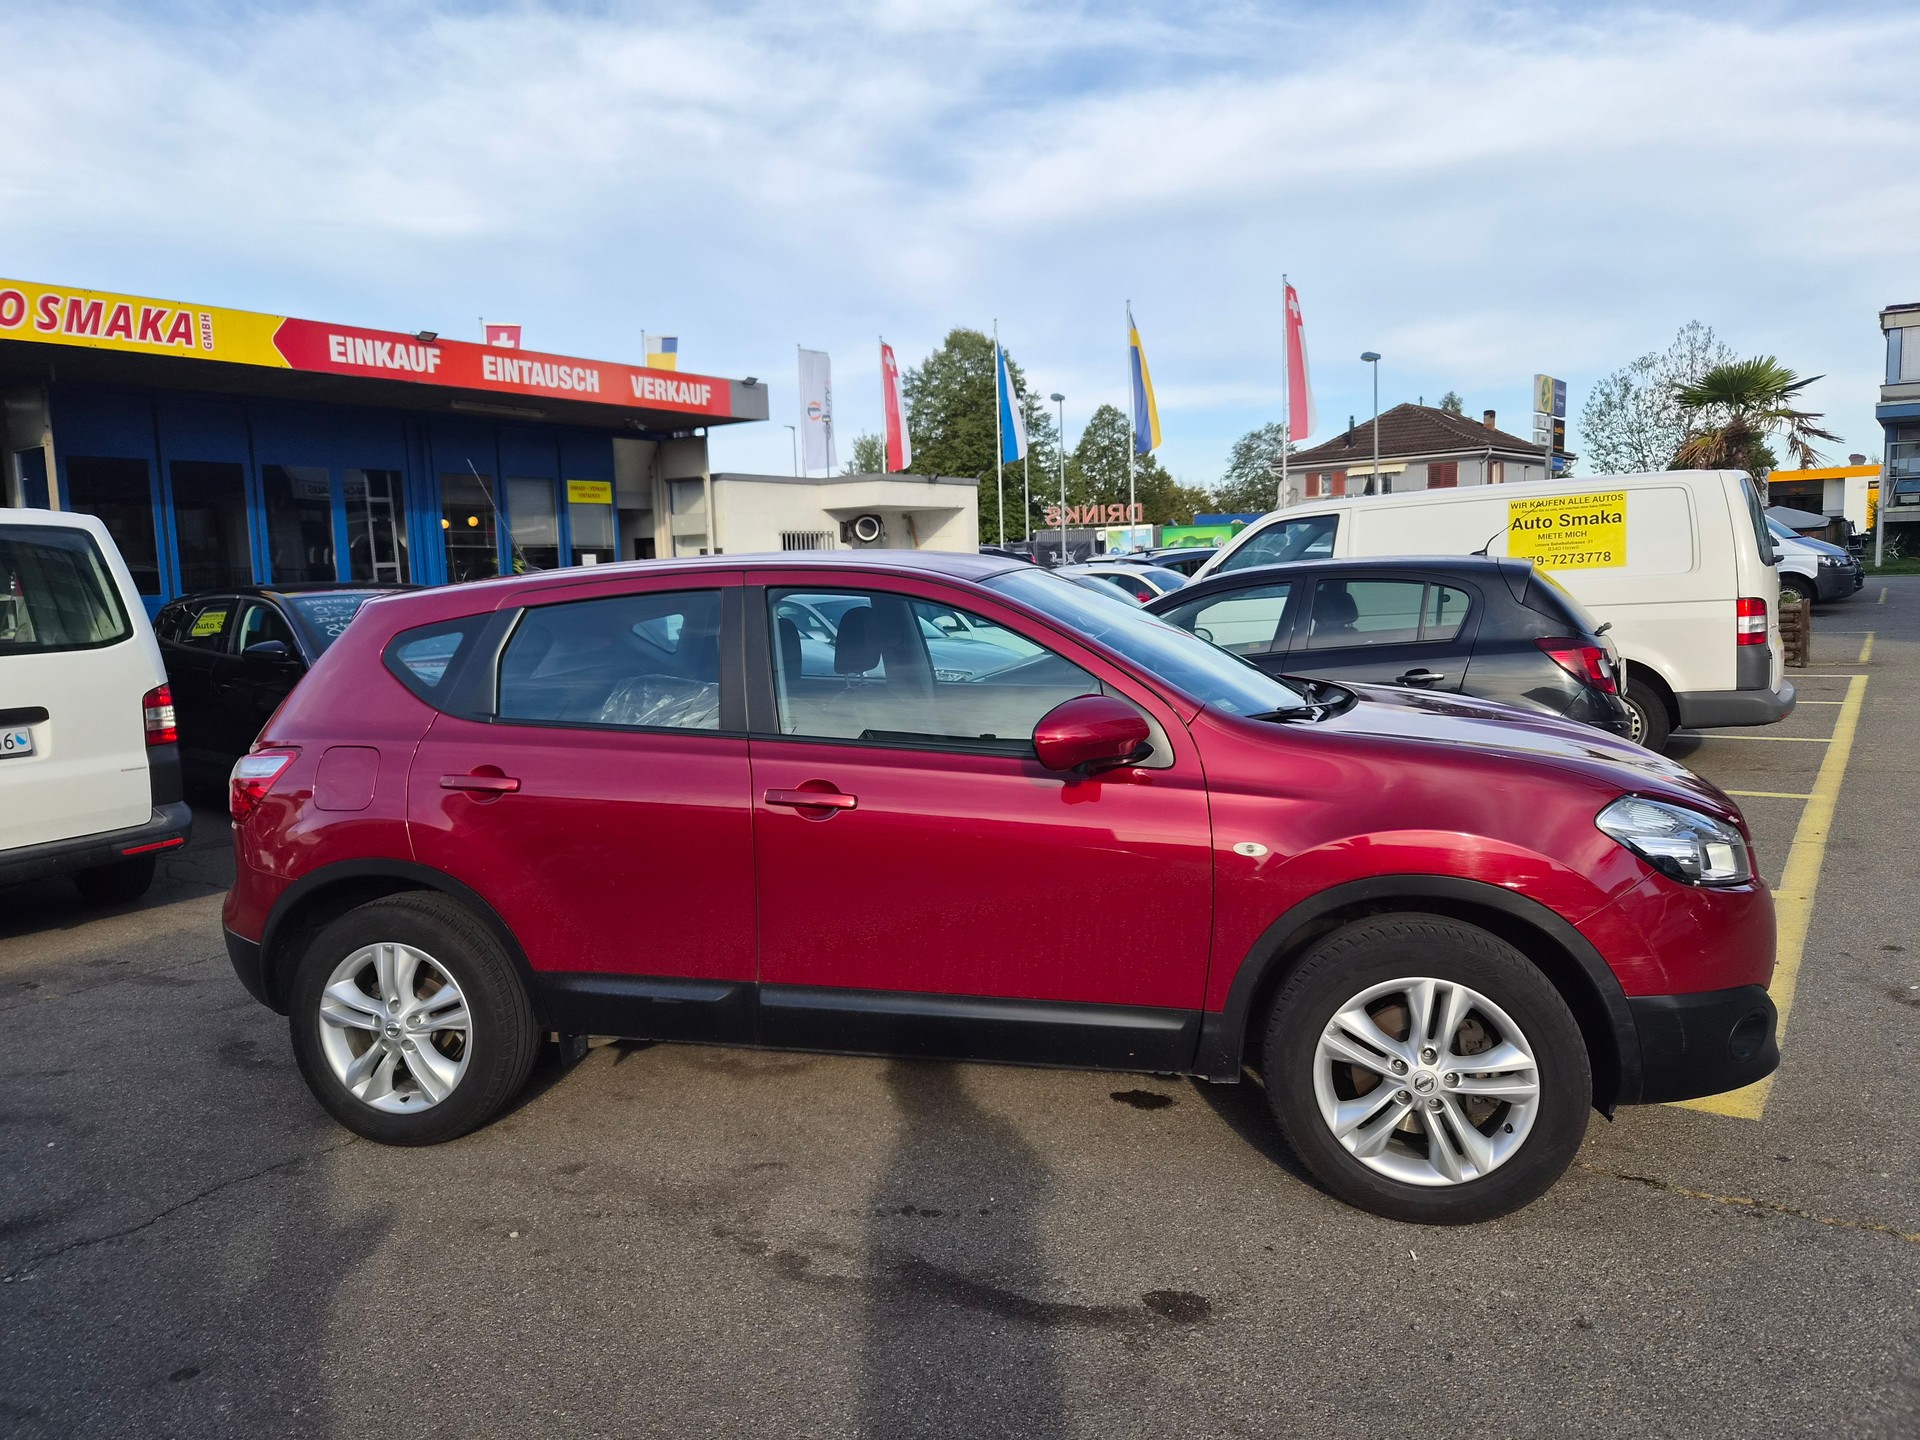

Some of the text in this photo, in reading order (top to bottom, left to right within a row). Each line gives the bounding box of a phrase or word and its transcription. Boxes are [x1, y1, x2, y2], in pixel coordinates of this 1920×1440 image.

[35, 295, 194, 347] SMAKA
[201, 313, 213, 350] GMBH
[328, 334, 712, 406] EINKAUF EINTAUSCH VERKAUF
[1530, 499, 1566, 509] KAUFEN
[1568, 497, 1590, 505] ALLE
[1592, 494, 1624, 503] AUTOS
[1511, 510, 1622, 531] Auto Smaka
[1538, 530, 1588, 540] MIETE MICH
[195, 622, 215, 631] Auto
